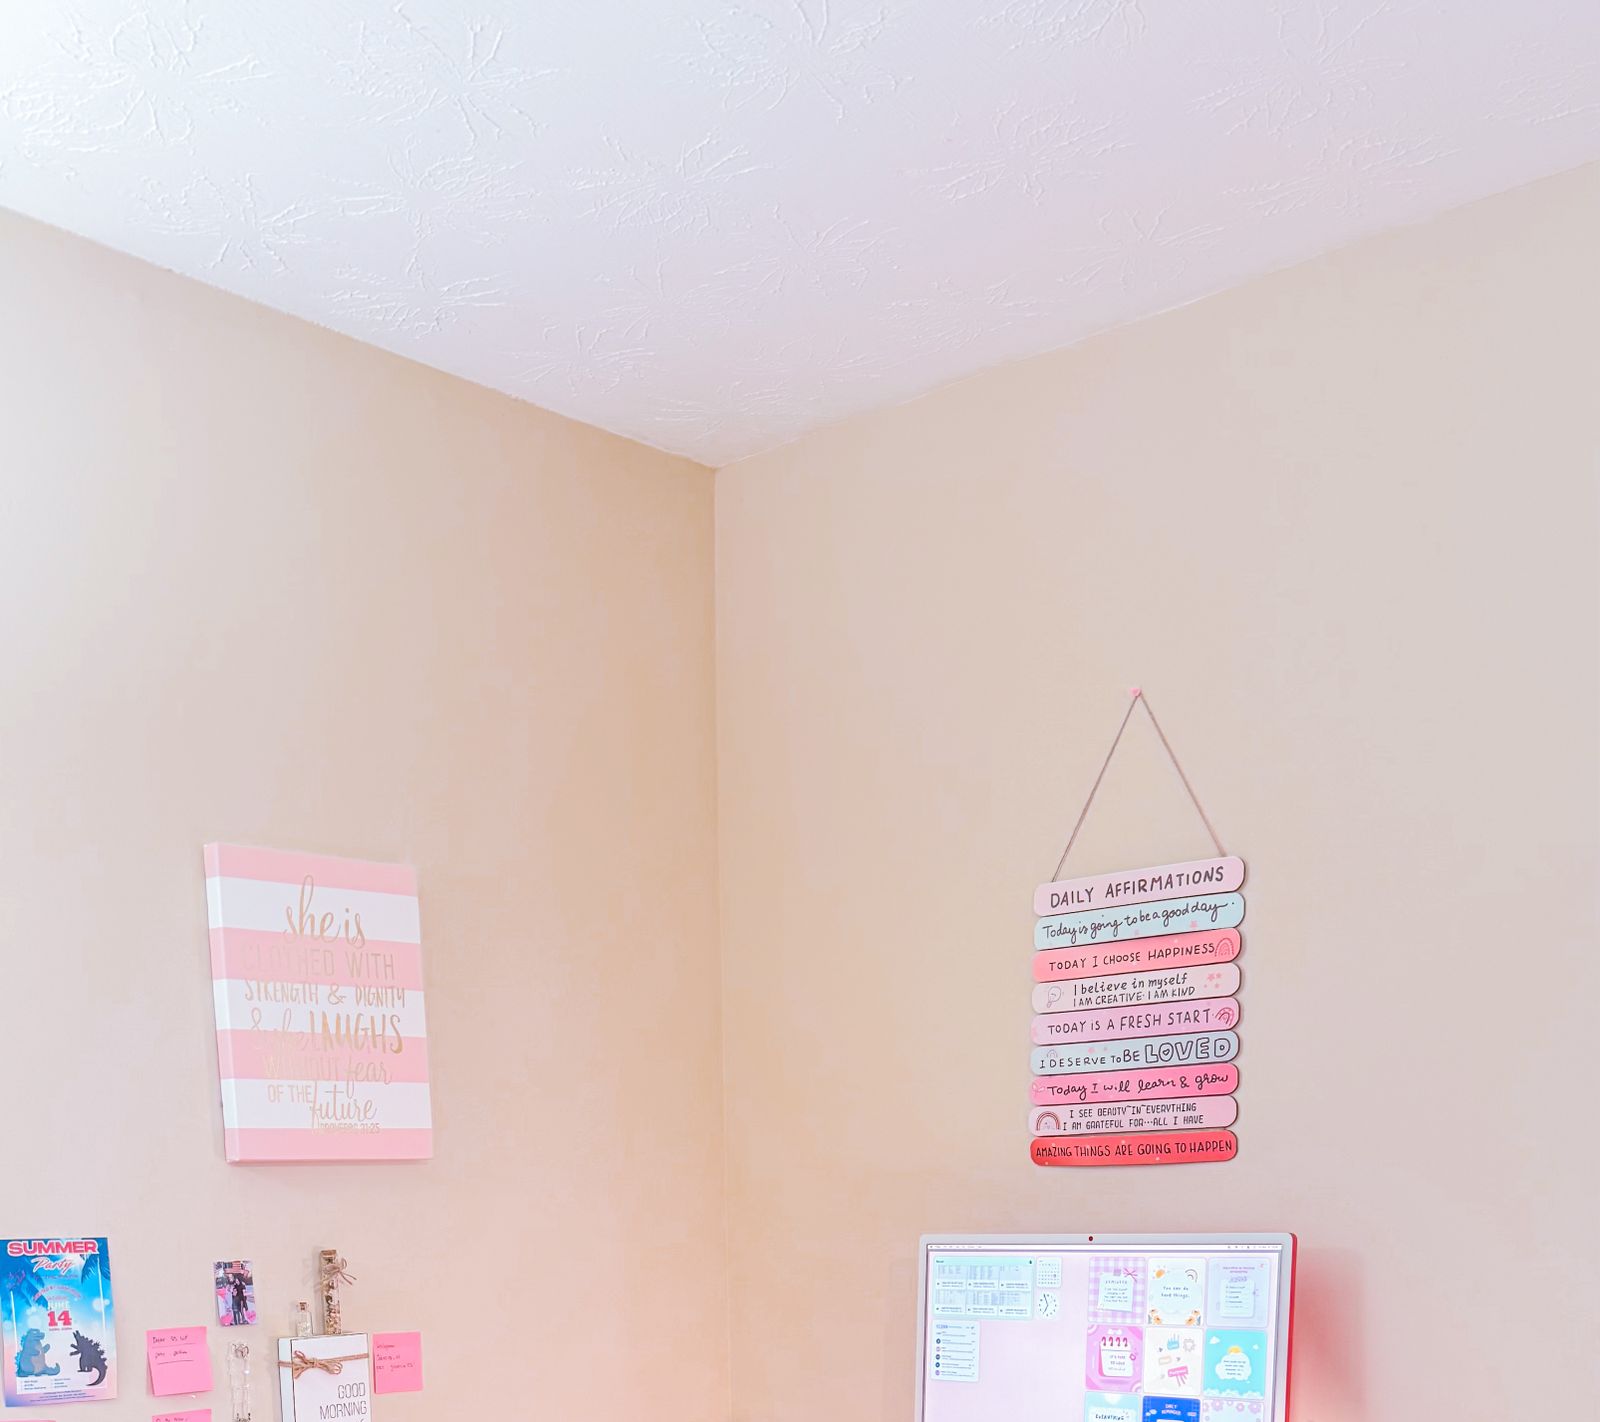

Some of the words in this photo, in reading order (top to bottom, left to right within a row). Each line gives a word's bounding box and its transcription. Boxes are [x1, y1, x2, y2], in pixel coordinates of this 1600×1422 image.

[1050, 887, 1094, 908] DAILY
[1105, 866, 1224, 898] AFFIRMATIONS
[283, 874, 341, 943] she
[344, 908, 365, 949] is
[1043, 923, 1077, 944] Today
[1079, 921, 1088, 934] is
[1091, 914, 1122, 939] going
[1124, 916, 1138, 926] to
[1140, 911, 1150, 922] be
[1161, 903, 1190, 927] good
[345, 951, 395, 980] WITH
[1049, 957, 1087, 971] TODAY
[1092, 955, 1098, 968] I
[1103, 951, 1141, 965] CHOOSE
[1148, 942, 1215, 961] HAPPINESS
[245, 978, 319, 1005] STRENGTH
[327, 983, 347, 1005] &
[355, 984, 405, 1008] DIGNITY
[1073, 999, 1076, 1007] I
[1079, 997, 1092, 1006] AM
[1148, 991, 1151, 999] I
[1154, 989, 1168, 999] AM
[1171, 986, 1196, 997] KIND
[1074, 984, 1077, 995] I
[1081, 981, 1127, 994] believe
[1132, 978, 1145, 989] in
[1148, 973, 1188, 990] myself
[309, 1010, 403, 1054] LAUGHS
[1048, 1021, 1087, 1035] TODAY
[1106, 1019, 1115, 1030] A
[1120, 1013, 1162, 1030] FRESH
[1168, 1008, 1211, 1025] START
[1039, 1060, 1044, 1069] I
[1049, 1056, 1106, 1068] DESERVE
[1123, 1049, 1140, 1062] BE
[1145, 1037, 1231, 1063] LOVED
[345, 1056, 392, 1099] fear
[1047, 1084, 1087, 1101] Today
[1091, 1083, 1098, 1093] I
[1103, 1080, 1130, 1093] will
[1137, 1076, 1177, 1093] learn
[1180, 1076, 1189, 1088] &
[1194, 1073, 1229, 1090] grow
[267, 1084, 284, 1103] OF
[287, 1085, 312, 1103] THE
[309, 1080, 378, 1129] future
[1069, 1110, 1074, 1118] I
[1079, 1108, 1093, 1118] SEE
[1062, 1122, 1067, 1130] I
[1072, 1121, 1081, 1129] AM
[1086, 1118, 1124, 1129] GRATEFUL
[1173, 1116, 1178, 1125] I
[1183, 1115, 1204, 1124] HAVE
[1036, 1146, 1072, 1157] AMAZING
[1074, 1144, 1111, 1157] THINGS
[1115, 1144, 1133, 1156] ARE
[1137, 1143, 1171, 1155] GOING
[1175, 1142, 1186, 1153] TO
[1189, 1140, 1232, 1153] HAPPEN
[7, 1240, 99, 1256] SUMMER
[31, 1257, 72, 1275] Party
[48, 1310, 72, 1327] 14
[338, 1382, 366, 1399] GOOD
[320, 1401, 367, 1420] MORNING
